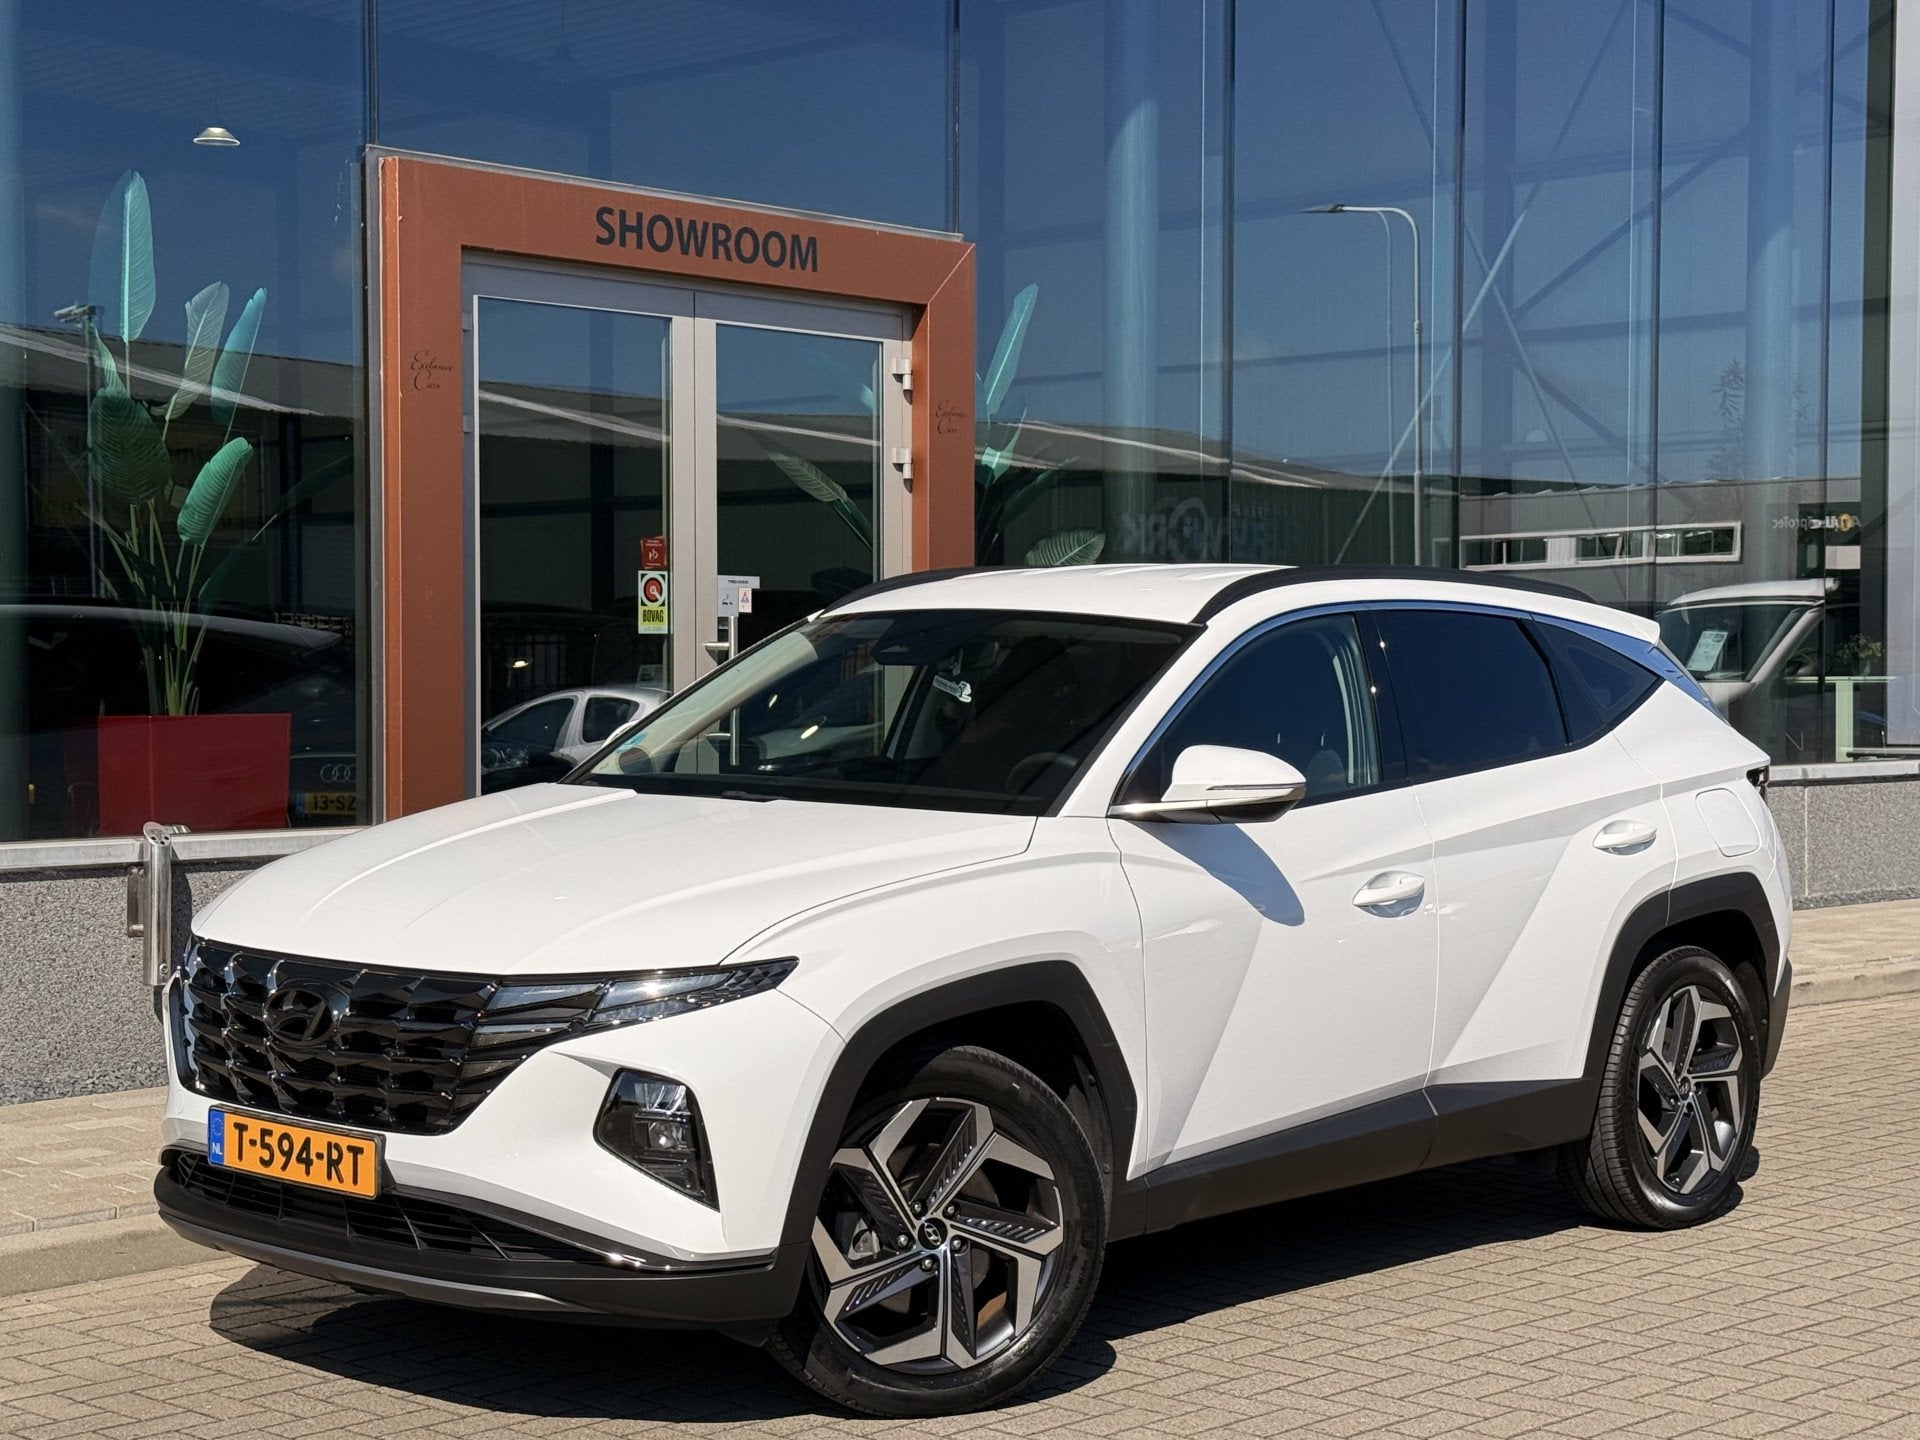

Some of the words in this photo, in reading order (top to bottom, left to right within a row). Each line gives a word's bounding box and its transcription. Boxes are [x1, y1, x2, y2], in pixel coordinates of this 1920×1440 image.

[595, 206, 818, 274] SHOWROOM
[642, 609, 665, 623] BOVAG
[211, 1141, 223, 1156] NL
[233, 1121, 365, 1187] T-594-RT
